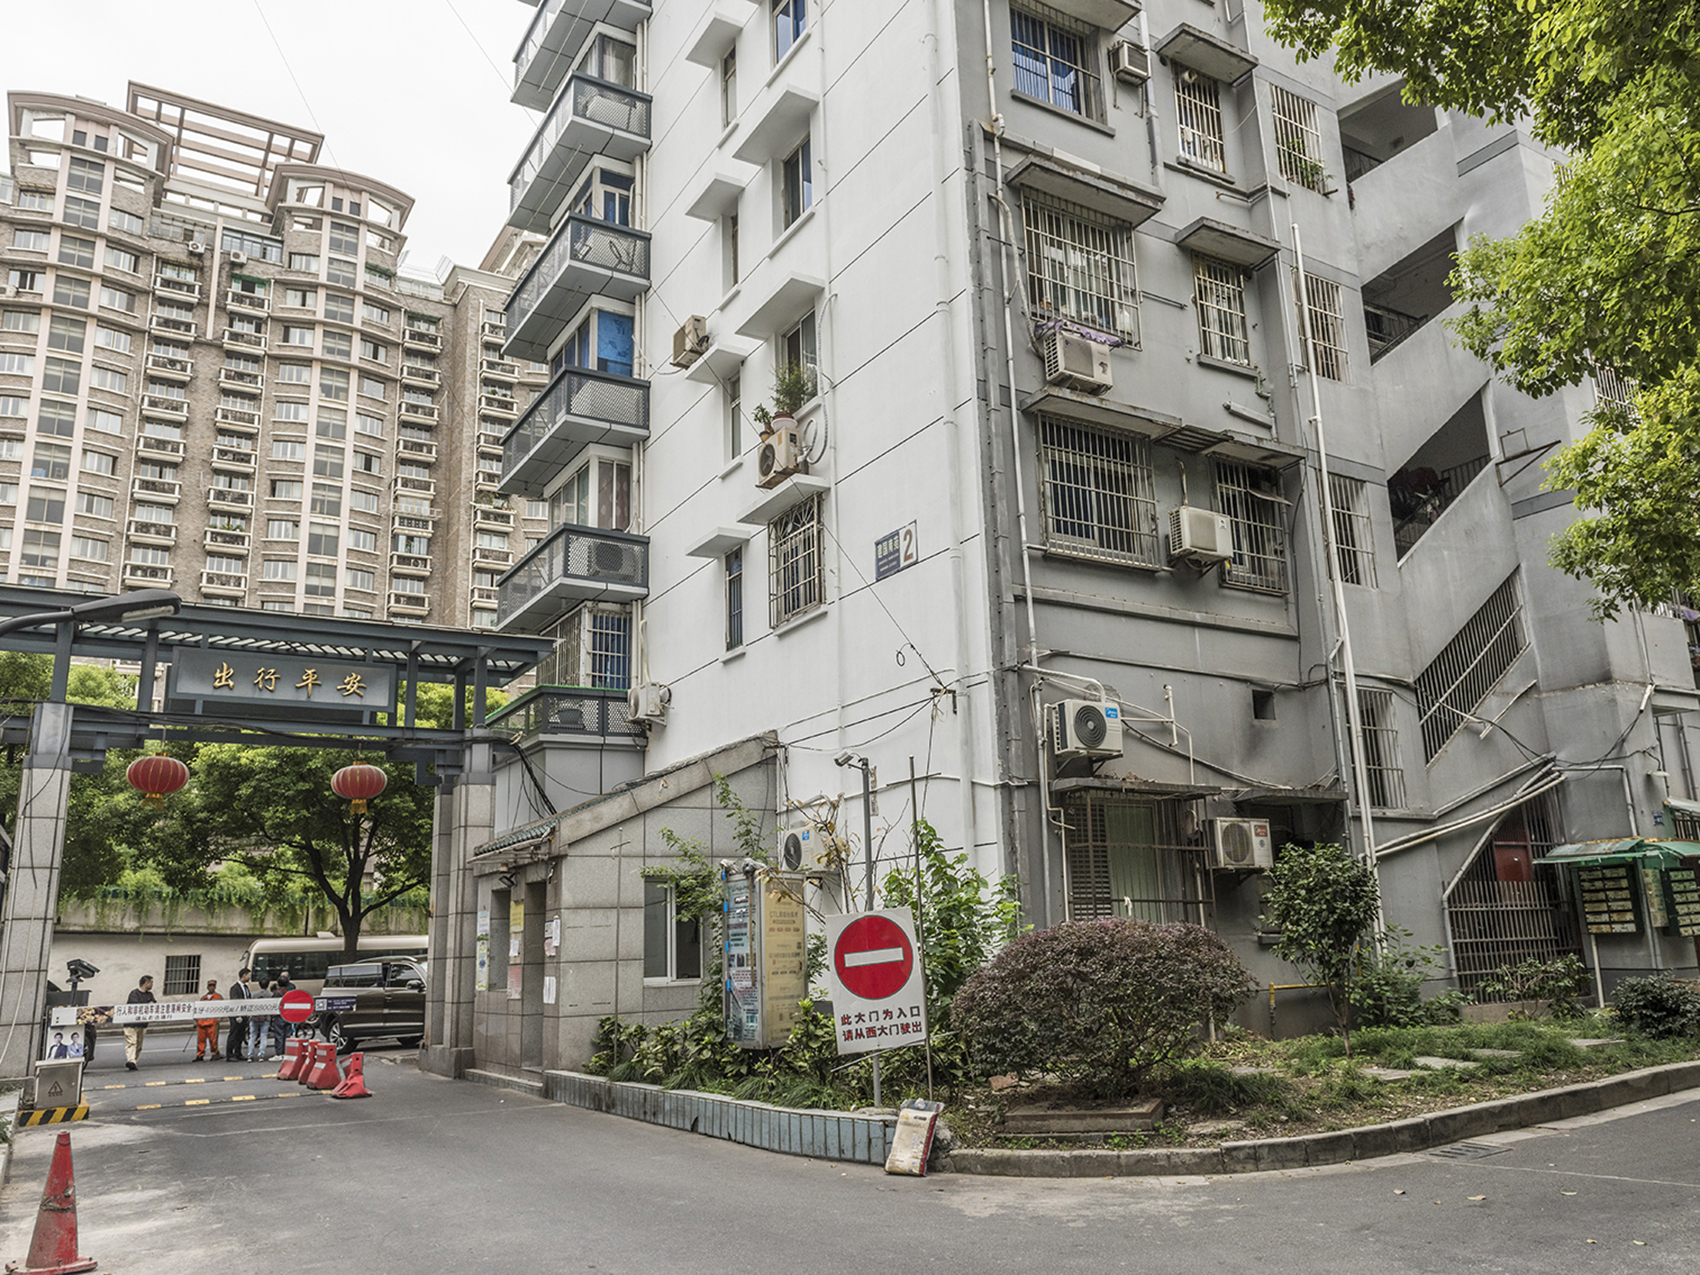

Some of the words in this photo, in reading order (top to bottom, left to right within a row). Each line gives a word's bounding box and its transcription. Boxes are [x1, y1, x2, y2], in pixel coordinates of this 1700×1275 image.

[903, 528, 914, 563] 2
[213, 662, 367, 697] 出行平安
[840, 1005, 921, 1026] 此大门为入口
[842, 1021, 923, 1042] 请从西大门驶出
